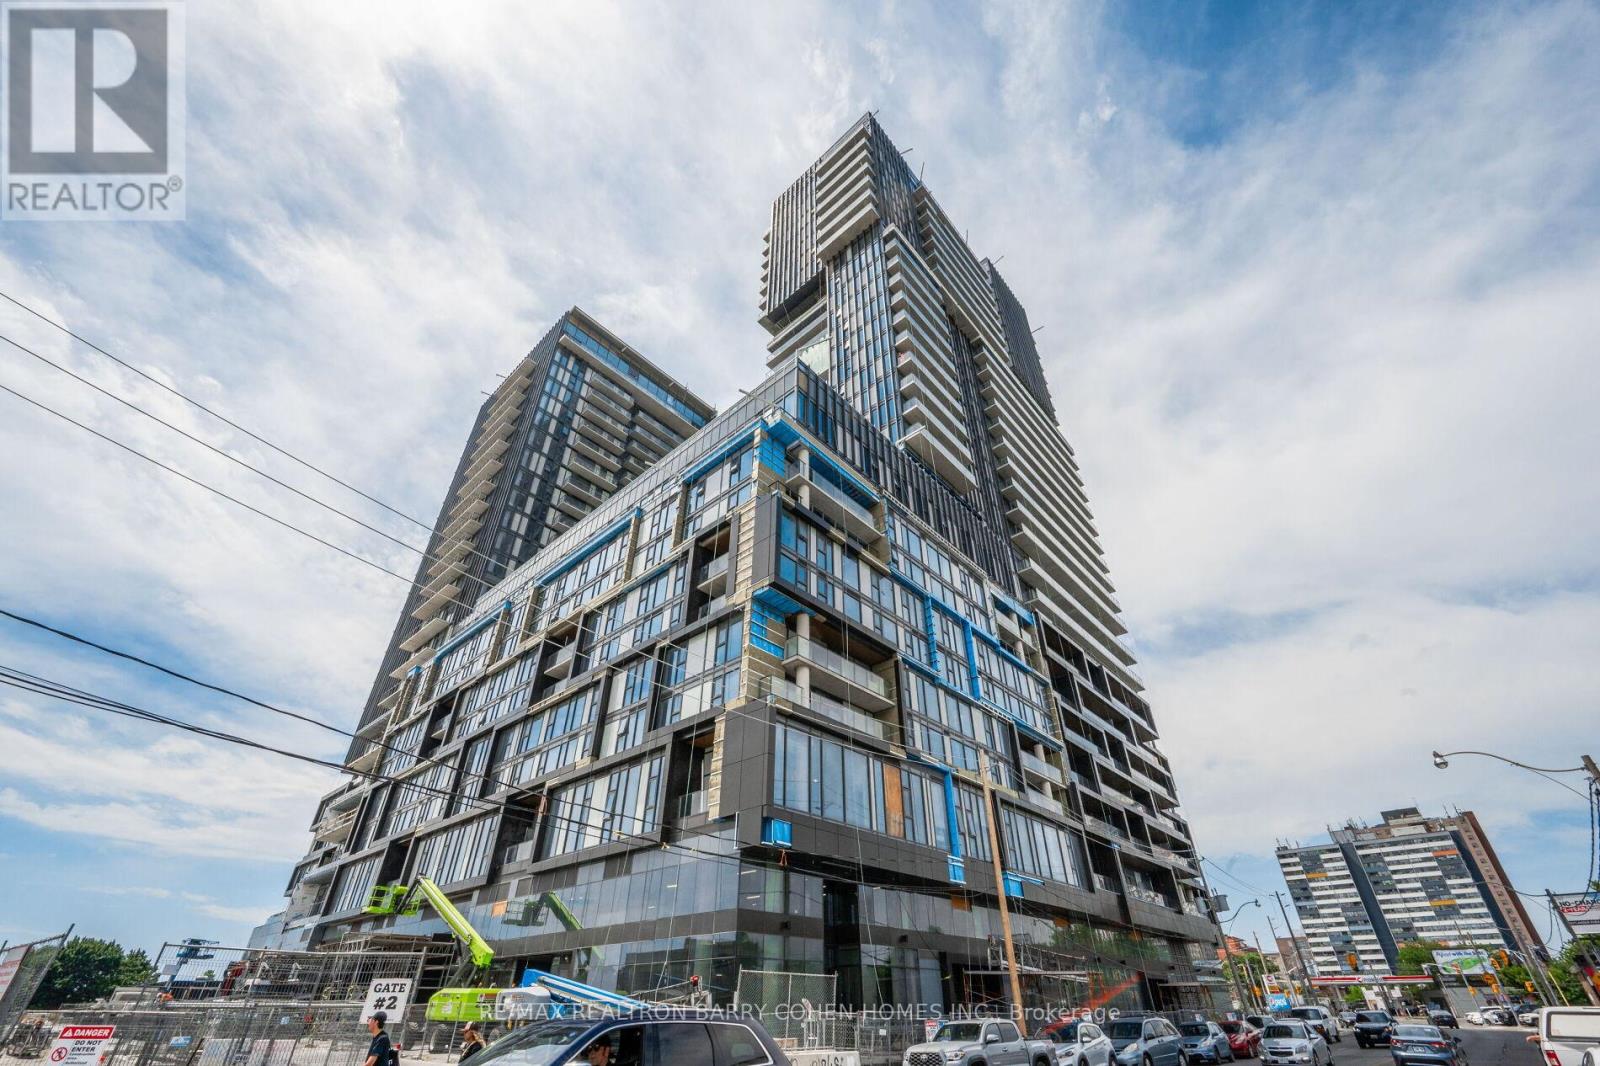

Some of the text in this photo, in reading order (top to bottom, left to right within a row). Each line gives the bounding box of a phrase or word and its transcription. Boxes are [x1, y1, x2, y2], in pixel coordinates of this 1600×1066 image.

[374, 983, 406, 993] GATE
[373, 996, 397, 1009] #2
[74, 1029, 110, 1037] DANGER
